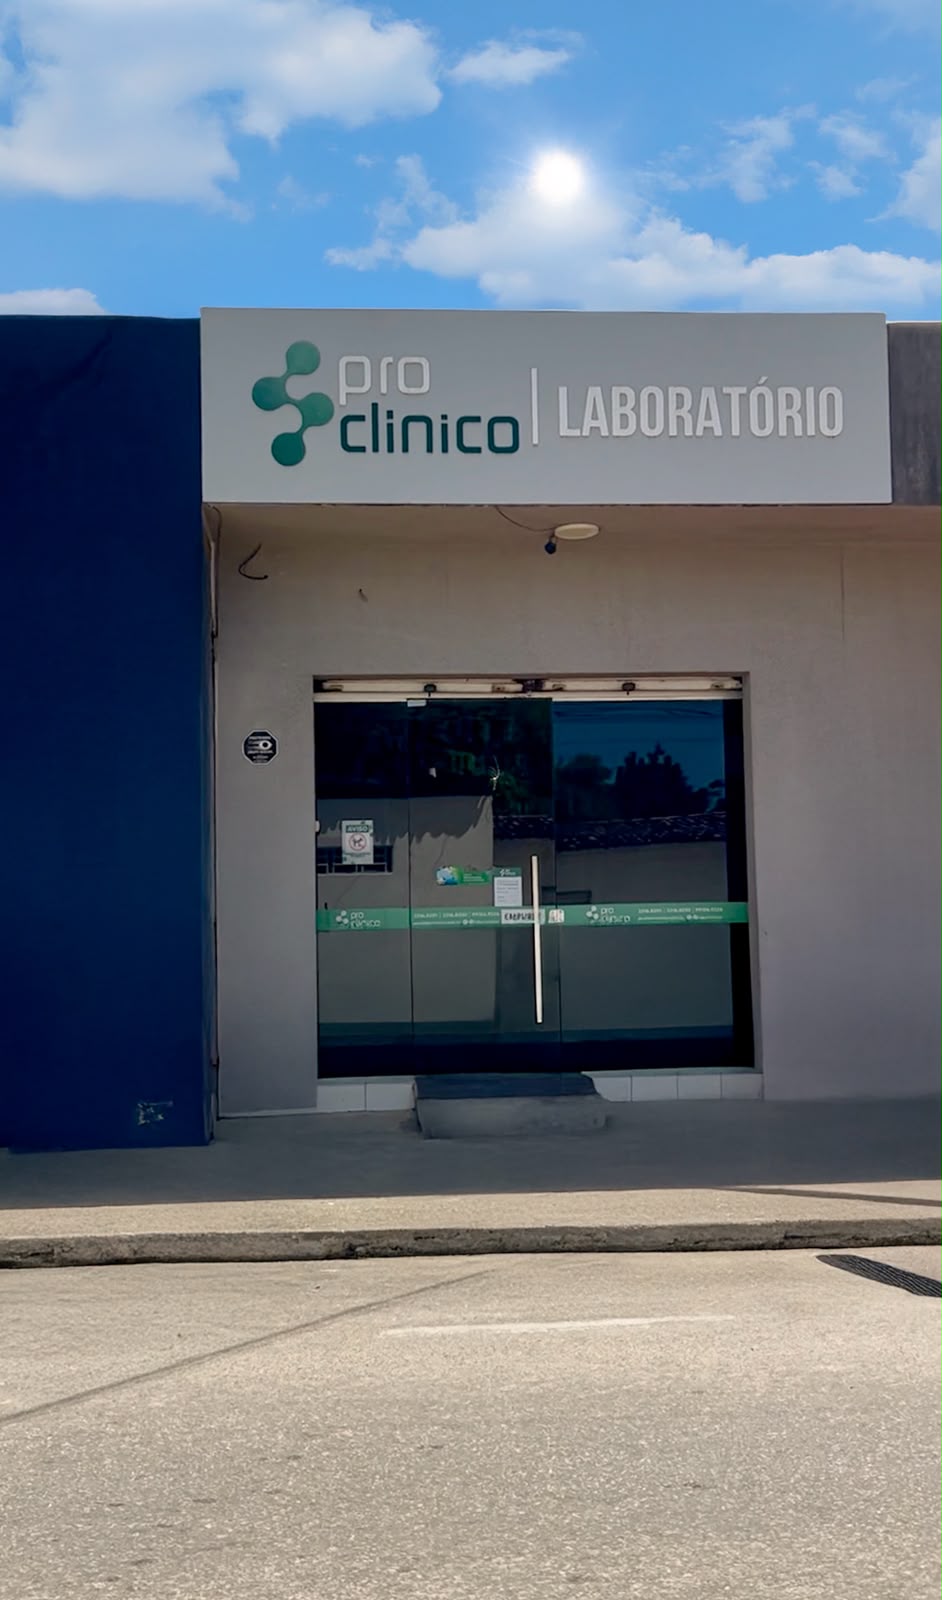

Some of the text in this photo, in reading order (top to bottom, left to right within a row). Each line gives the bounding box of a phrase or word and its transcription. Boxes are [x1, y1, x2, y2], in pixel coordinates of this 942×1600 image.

[337, 354, 432, 407] pro
[558, 376, 845, 438] LABORATÓRIO
[340, 401, 520, 455] clinico
